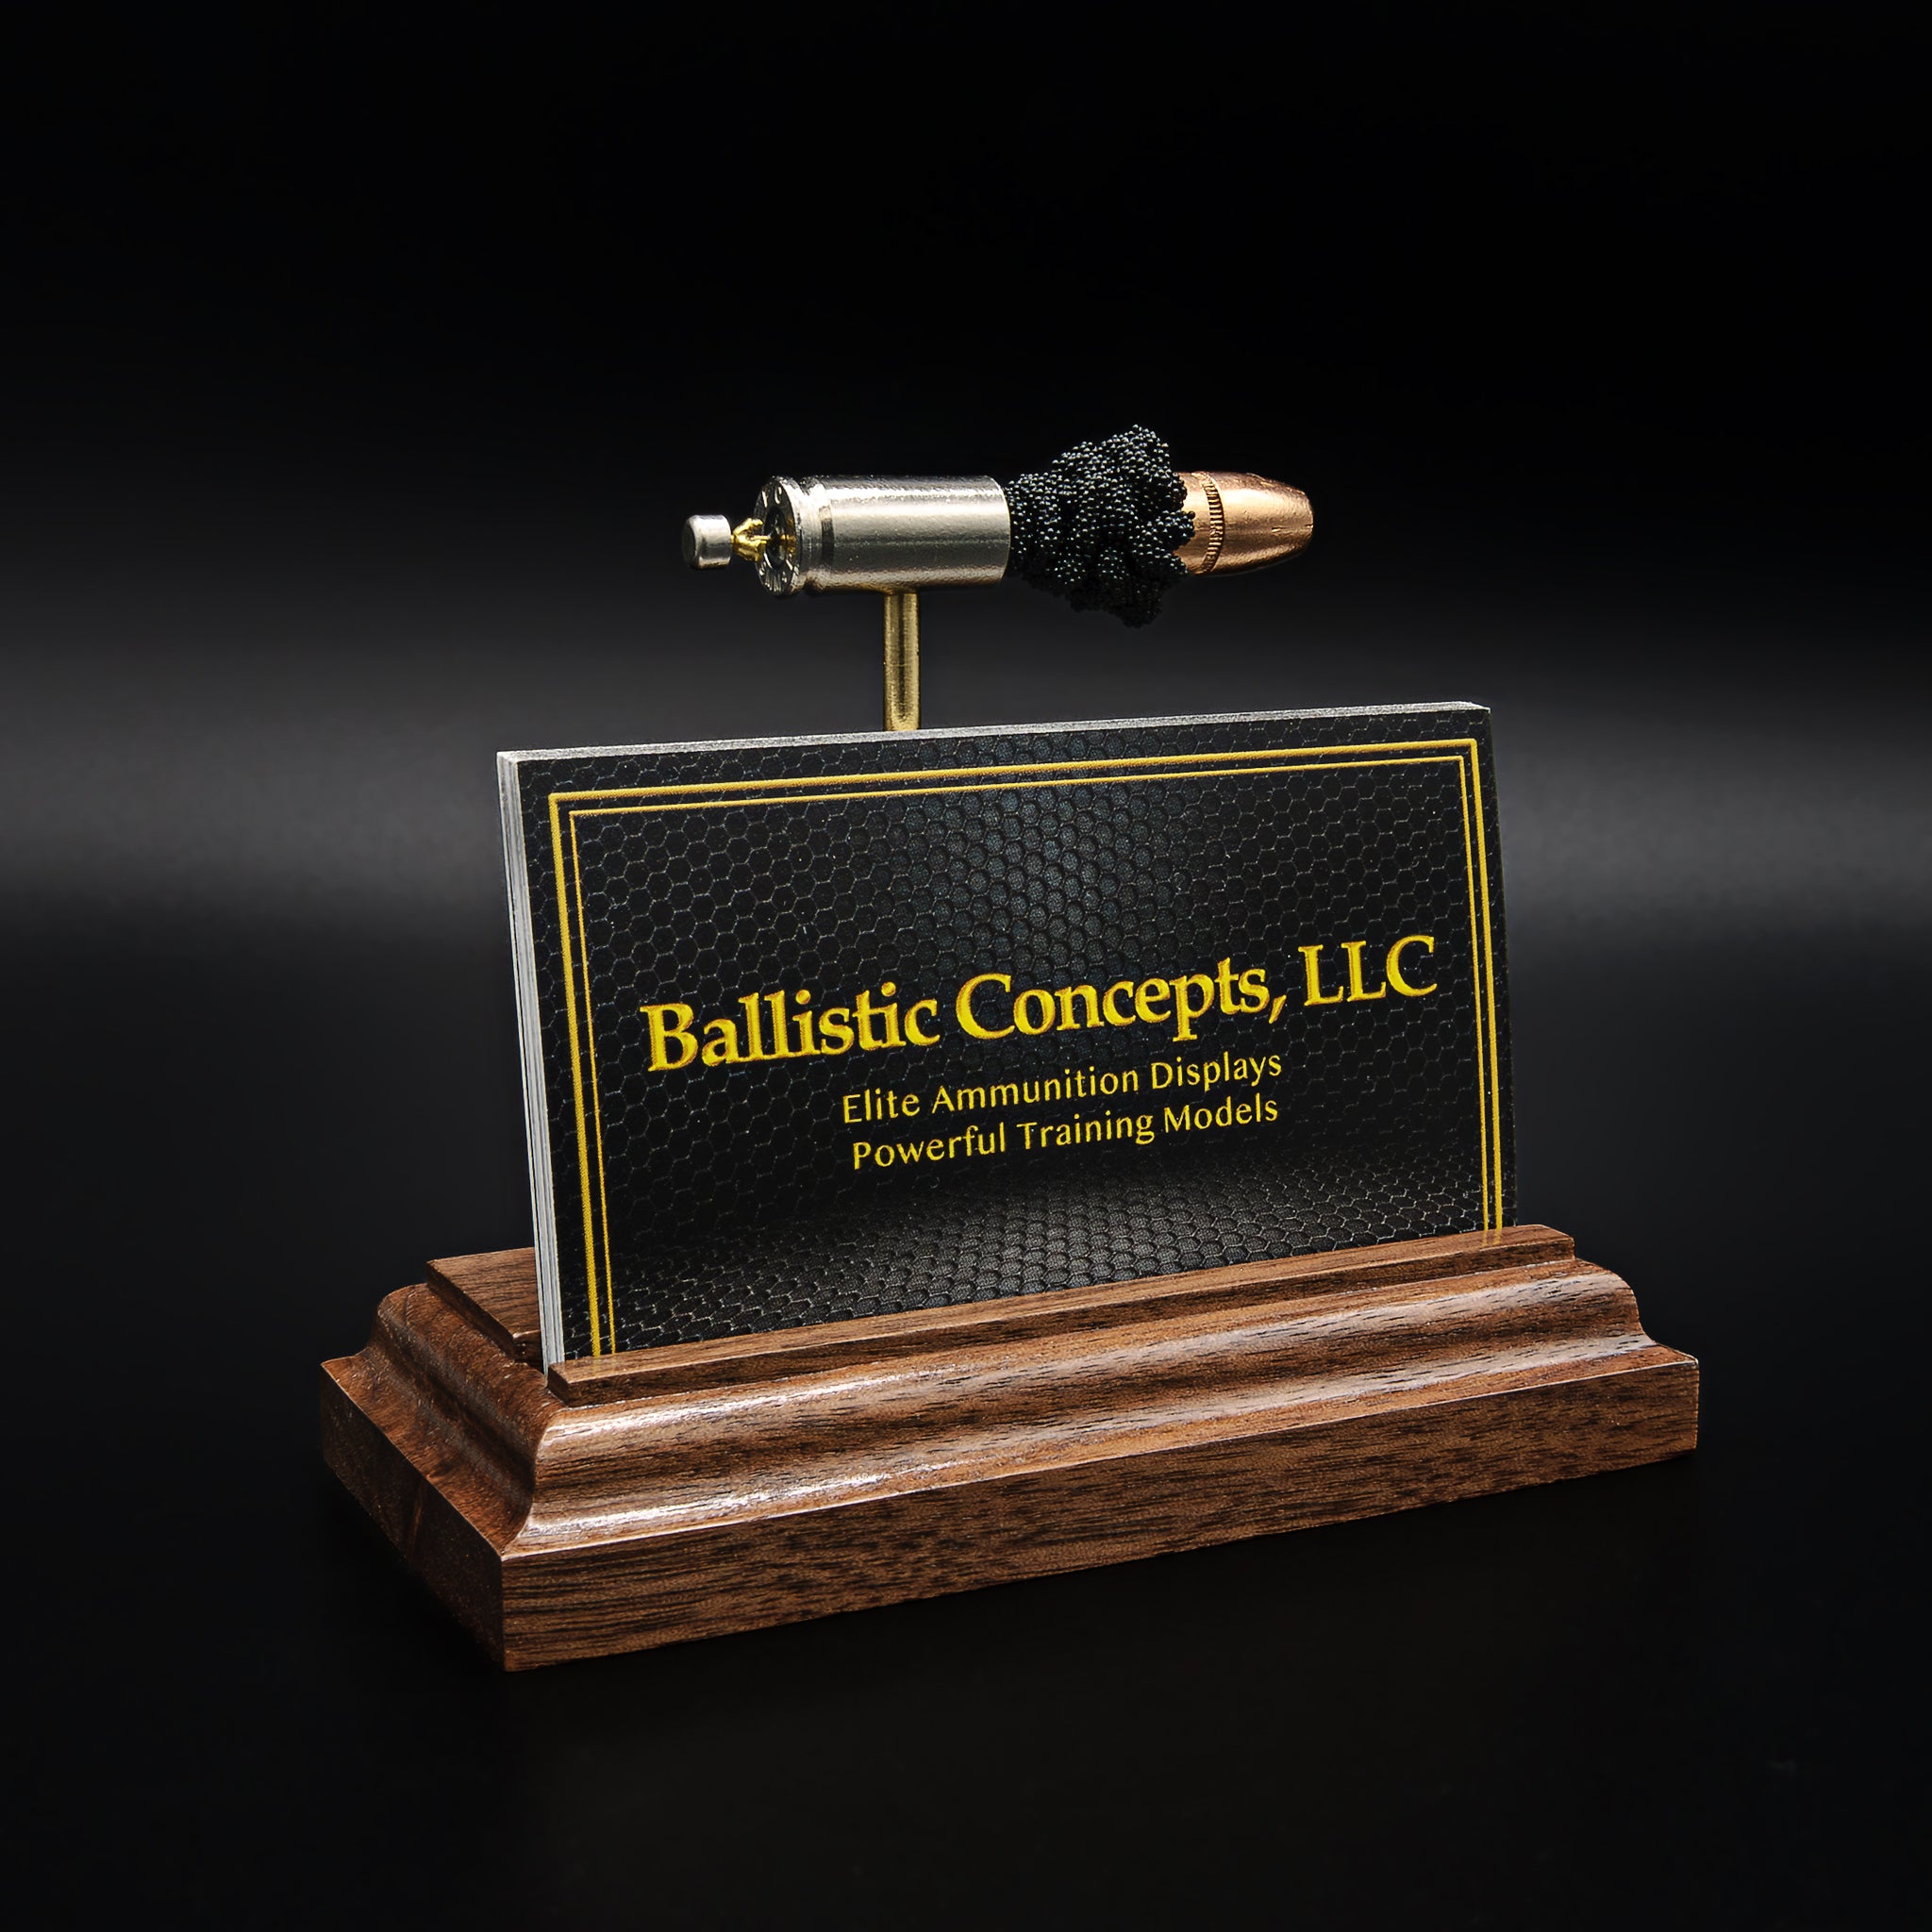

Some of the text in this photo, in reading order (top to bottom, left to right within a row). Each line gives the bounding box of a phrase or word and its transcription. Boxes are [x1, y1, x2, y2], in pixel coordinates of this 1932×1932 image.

[639, 934, 1438, 1073] Ballistic Concepts, LLC
[842, 1050, 1282, 1124] Elite Ammunition Displays
[852, 1091, 1278, 1170] Powerful Training Models
